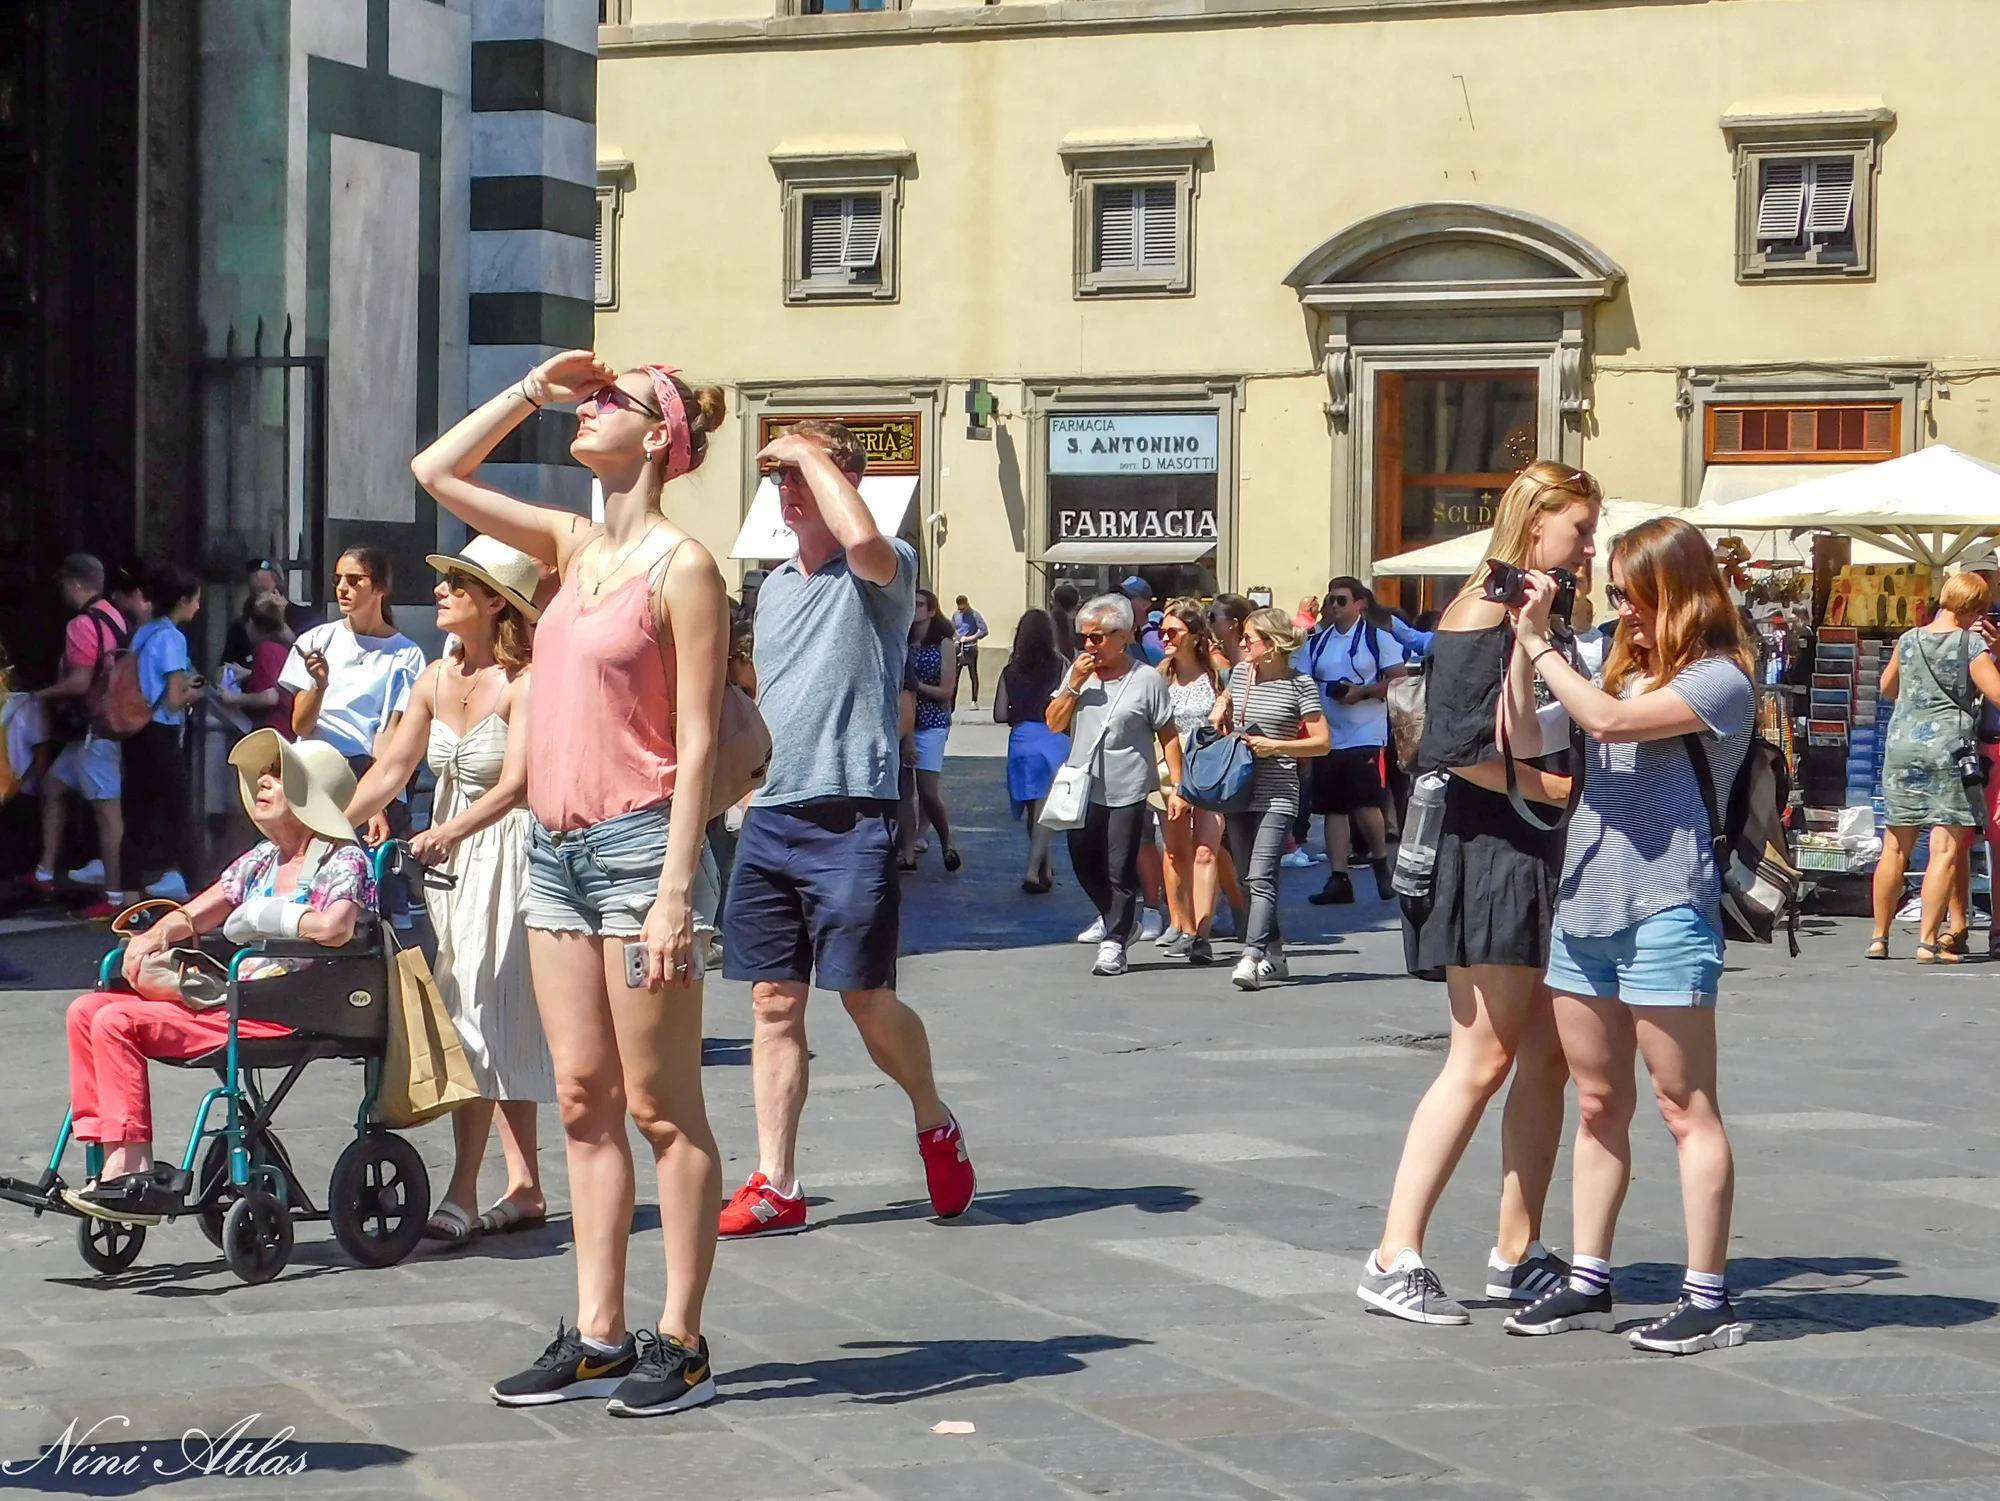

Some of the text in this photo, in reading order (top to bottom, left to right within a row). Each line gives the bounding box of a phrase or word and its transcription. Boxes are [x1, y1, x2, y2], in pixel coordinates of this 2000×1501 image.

[1052, 419, 1115, 432] FARMACIA
[1067, 436, 1200, 454] S. ANTONINO
[1156, 457, 1214, 470] MASOTTI
[1432, 502, 1499, 523] SCUD
[1058, 510, 1218, 538] FARMACIA
